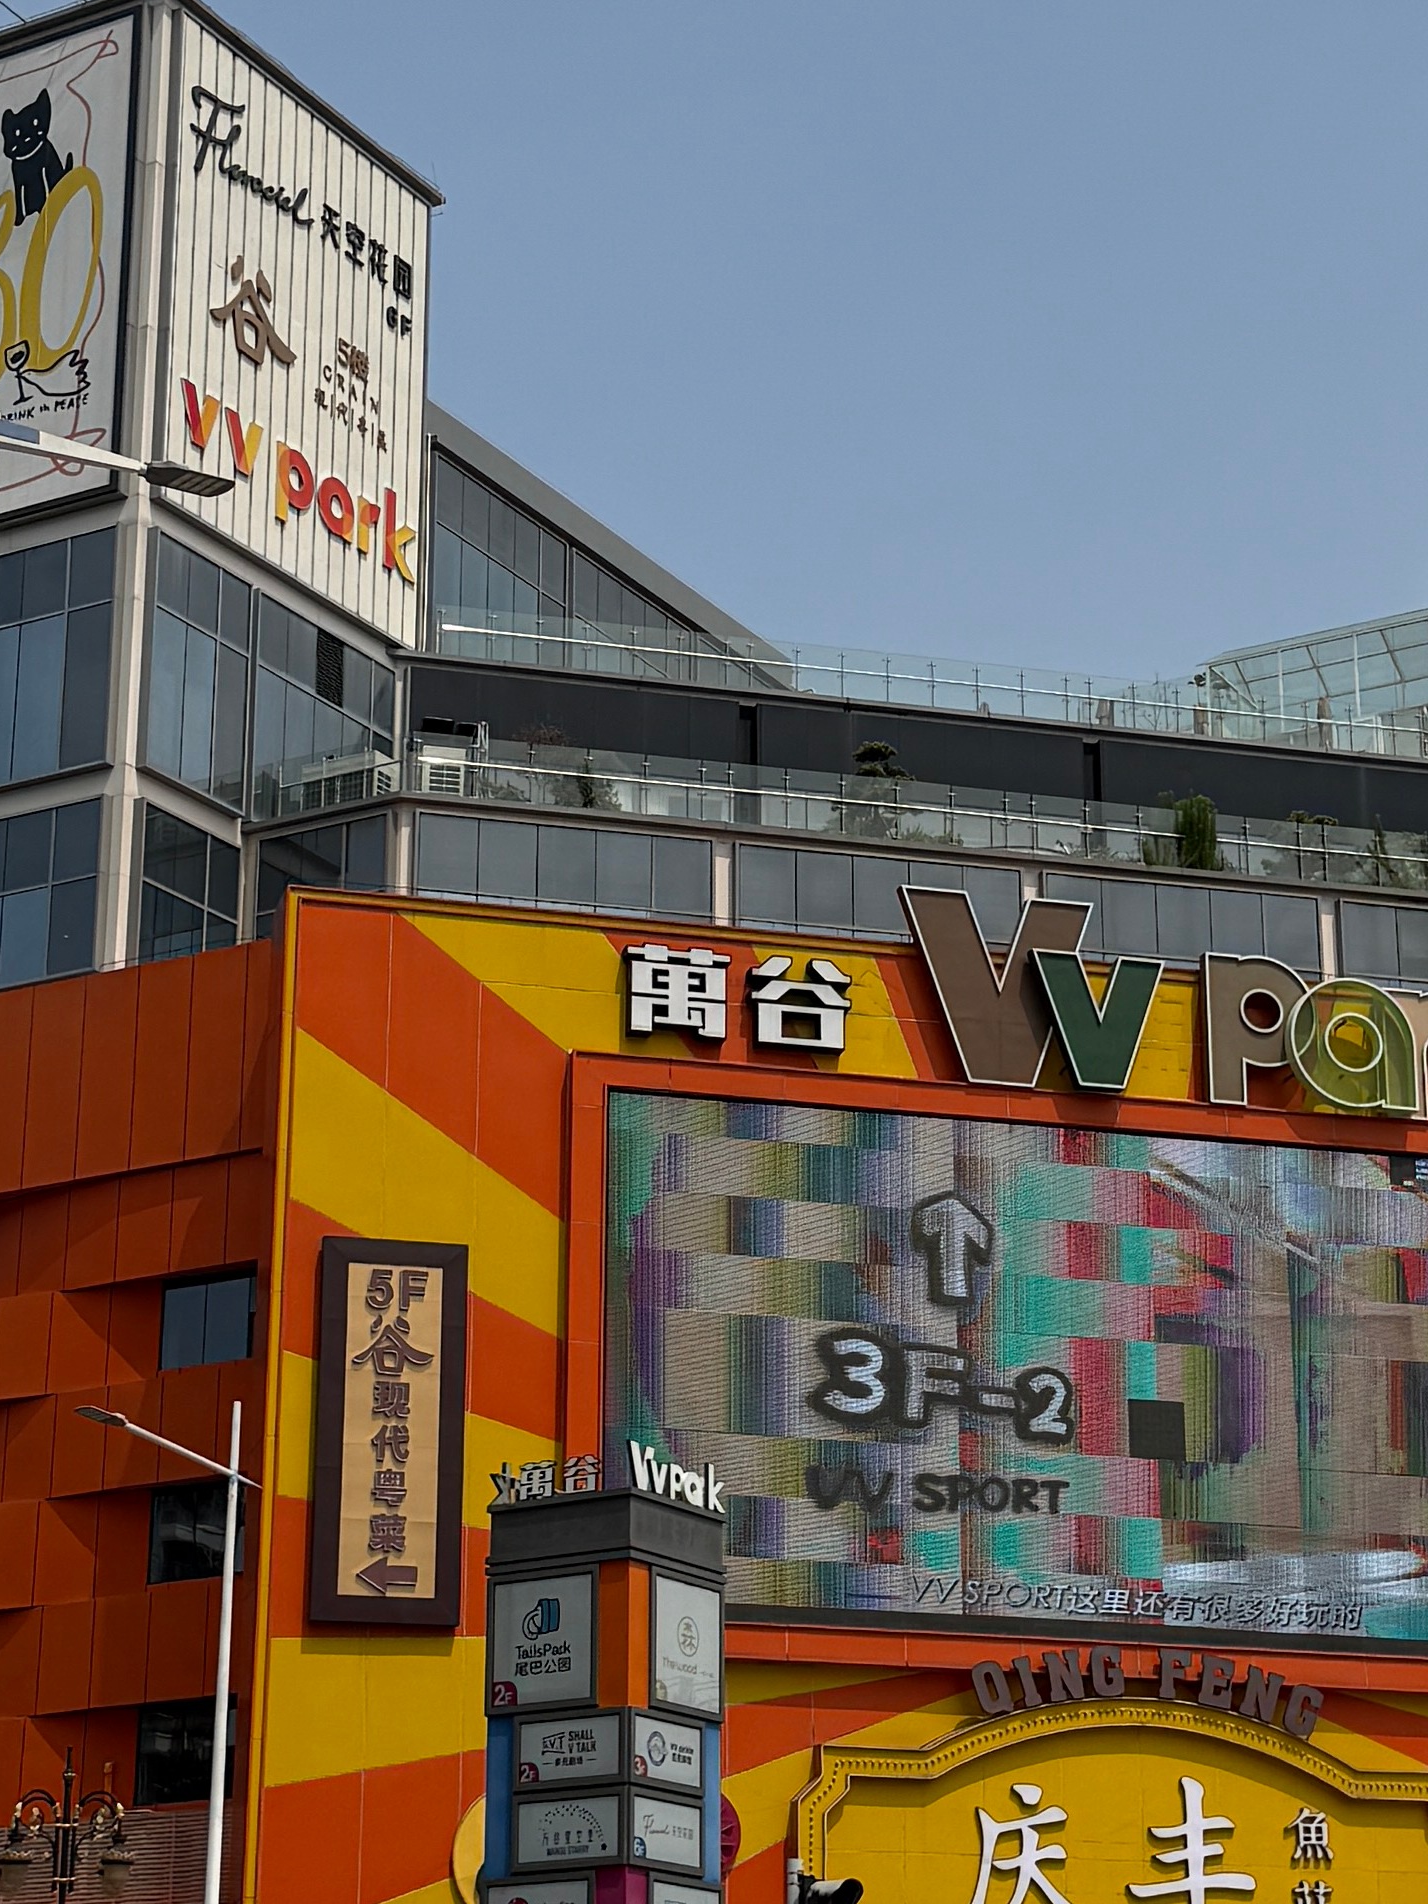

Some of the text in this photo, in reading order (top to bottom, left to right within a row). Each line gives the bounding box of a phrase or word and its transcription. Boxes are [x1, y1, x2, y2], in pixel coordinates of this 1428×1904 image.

[320, 202, 413, 300] 天空花园
[210, 254, 297, 365] 谷
[274, 440, 416, 584] park
[623, 941, 853, 1054] 萬谷
[368, 1268, 429, 1311] 5F
[810, 1330, 1075, 1442] 3F-2
[912, 1472, 1070, 1514] SPORT
[911, 1574, 956, 1605] VV
[494, 1684, 512, 1706] 2F
[972, 1644, 1324, 1740] QING FENG
[520, 1765, 536, 1782] 2F
